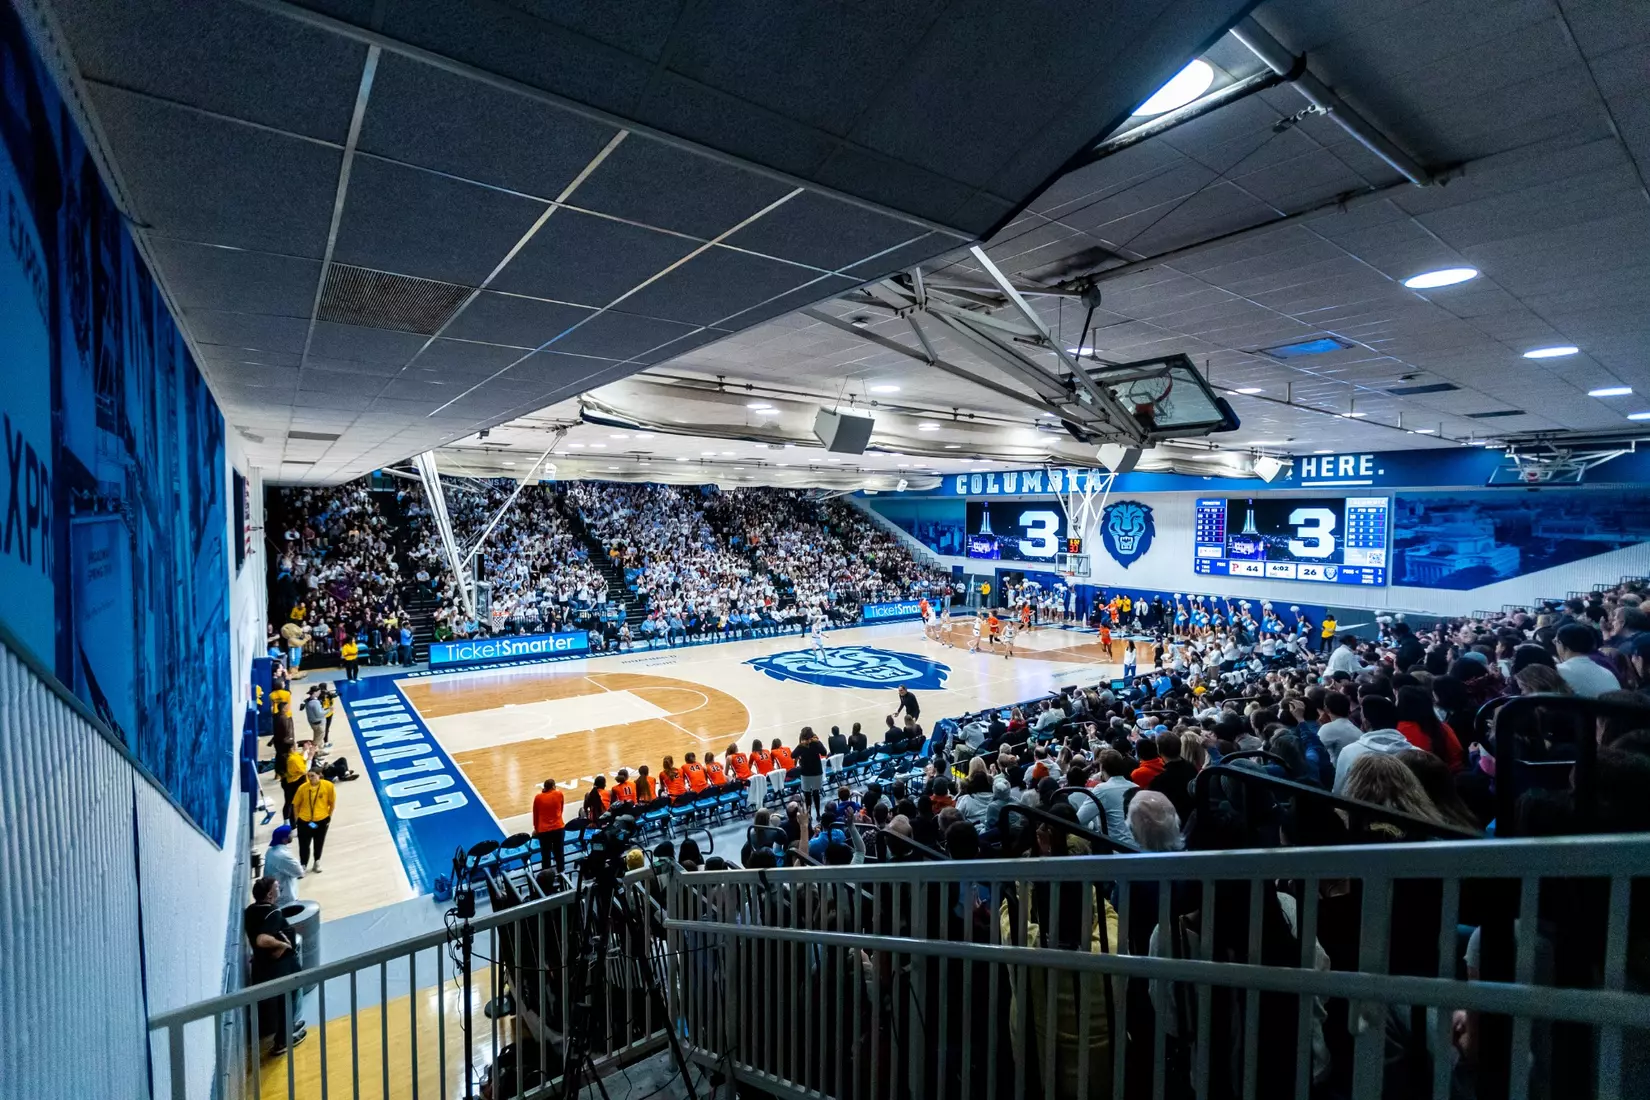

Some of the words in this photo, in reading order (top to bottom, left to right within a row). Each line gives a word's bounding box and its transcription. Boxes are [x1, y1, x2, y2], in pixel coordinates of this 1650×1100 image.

[1301, 454, 1384, 478] HERE.
[956, 468, 1104, 495] COLUMBIA
[1019, 510, 1060, 558] 3
[1288, 508, 1337, 558] 3
[1231, 562, 1239, 572] P
[1303, 568, 1317, 576] 26
[445, 635, 574, 661] TicketSmarter
[349, 694, 469, 820] COLUMBIA
[690, 764, 701, 772] 44
[623, 786, 632, 795] 11
